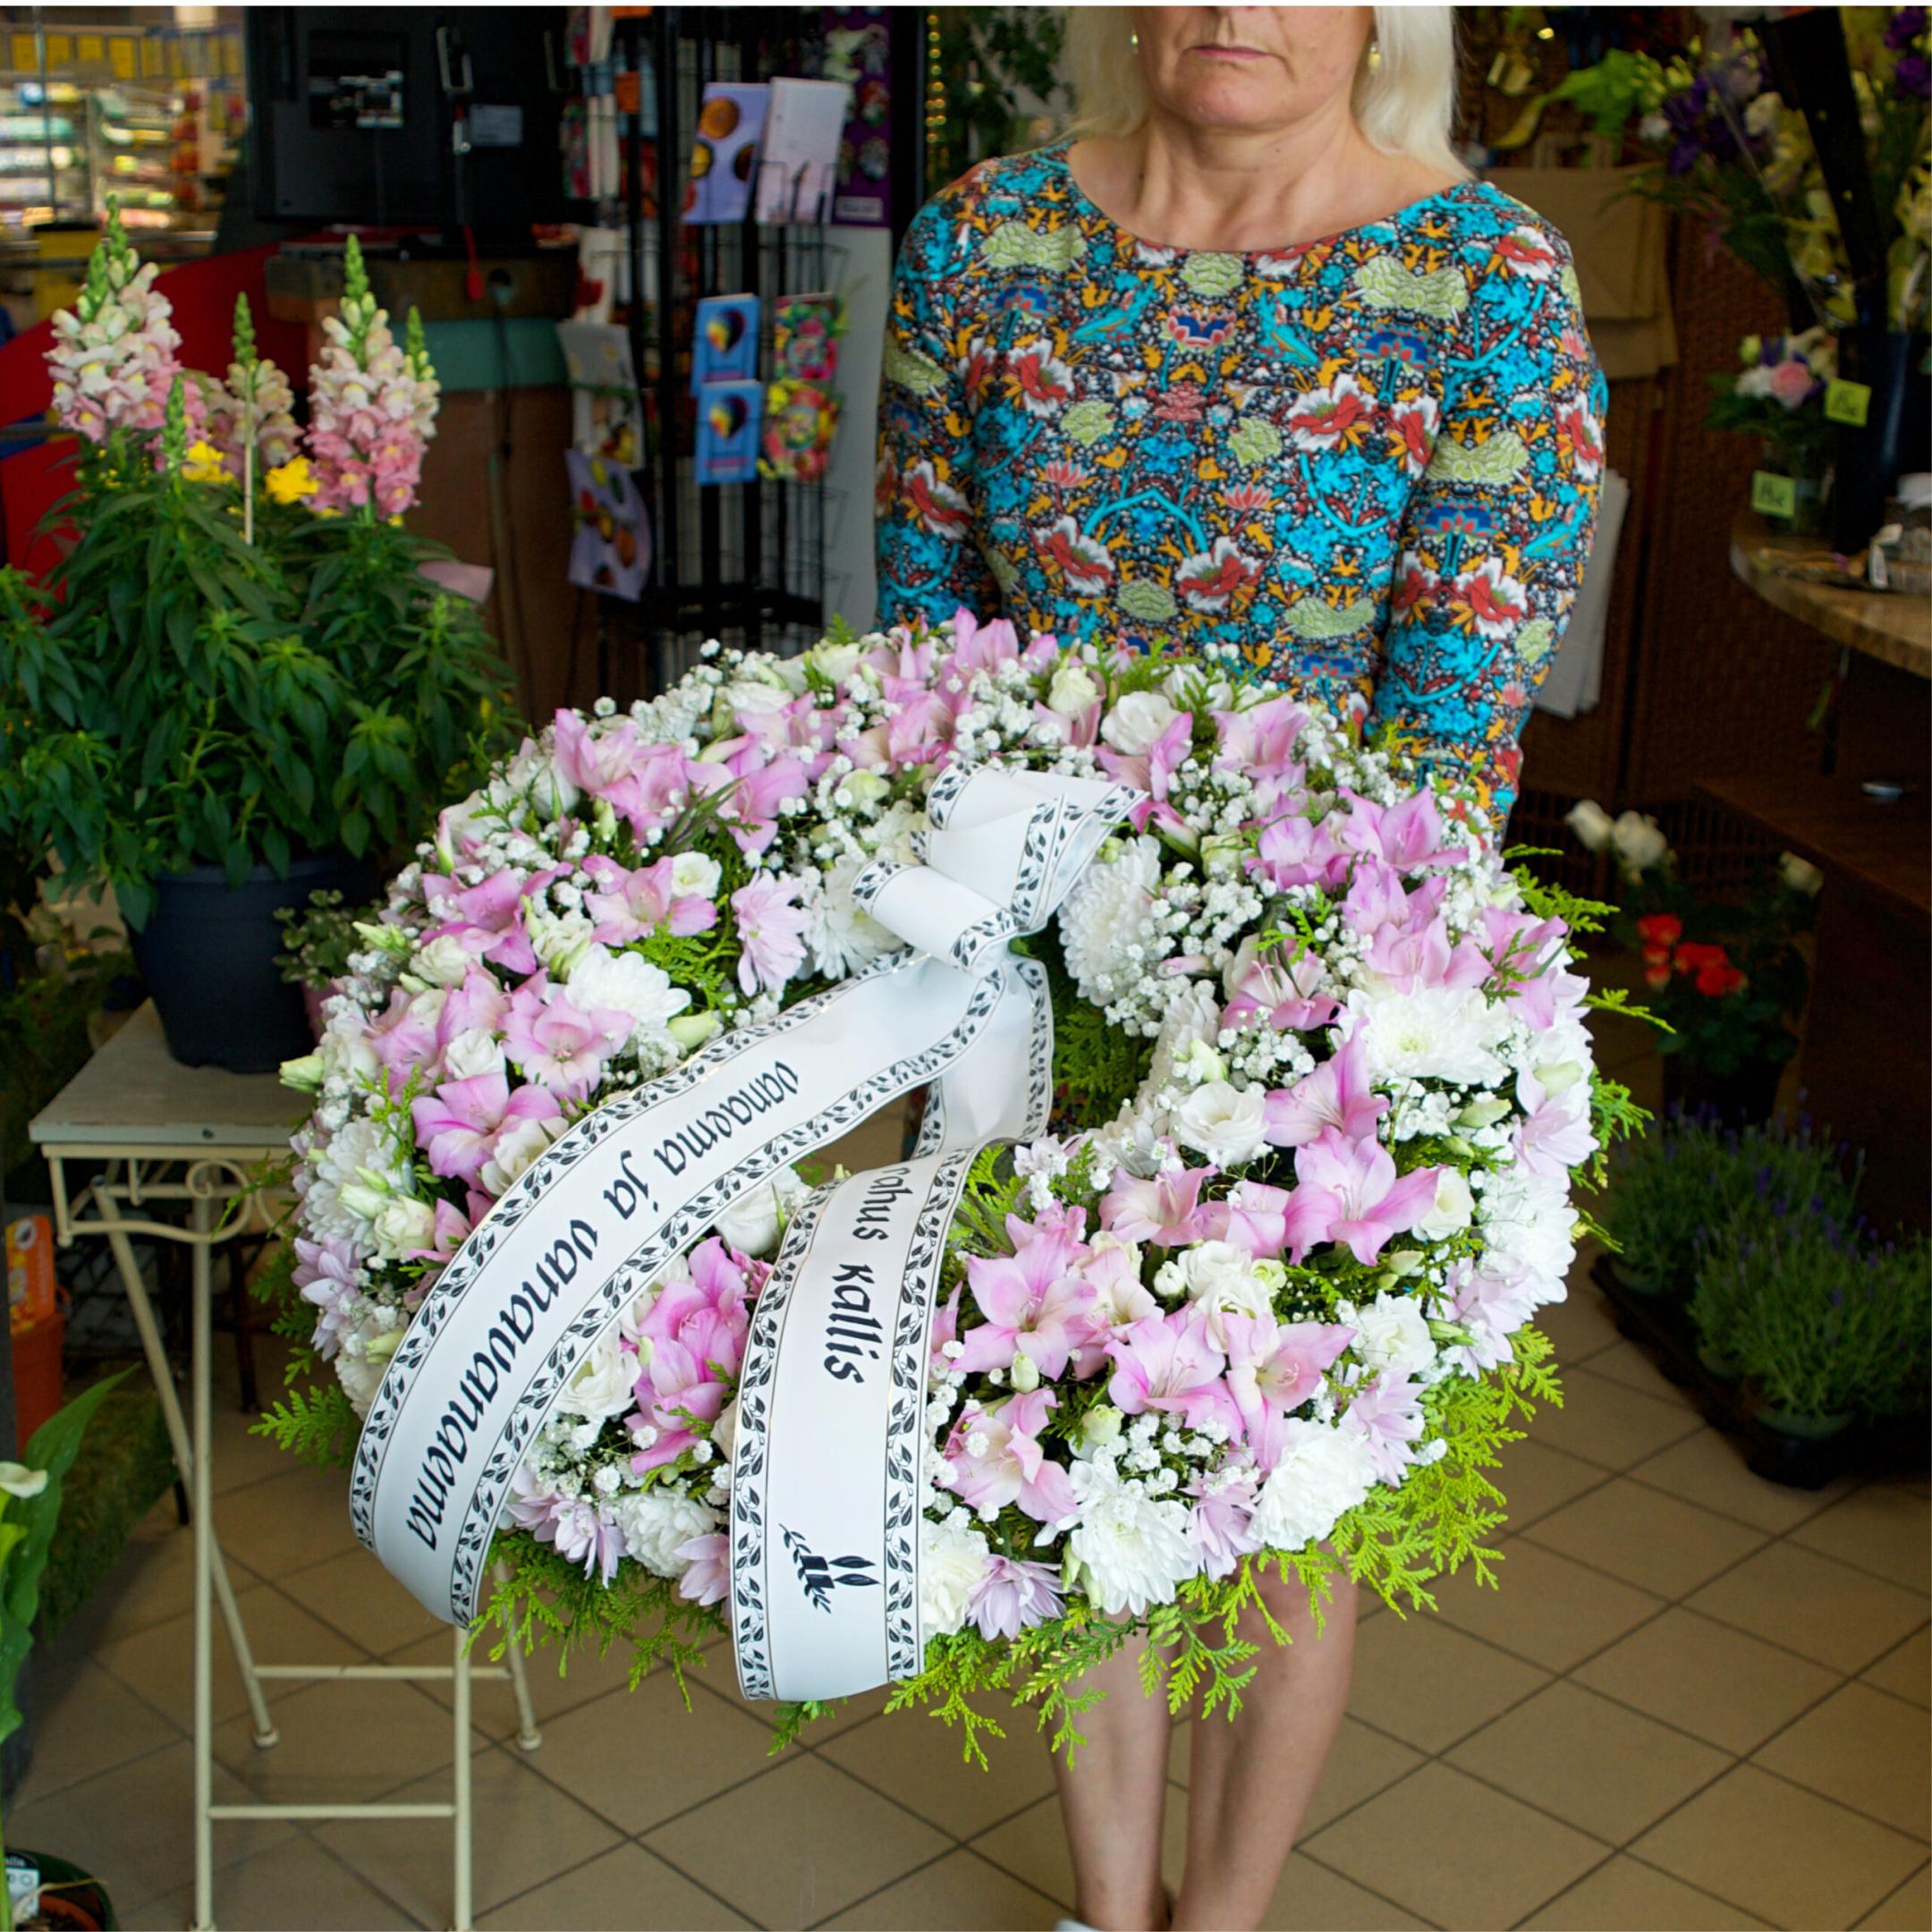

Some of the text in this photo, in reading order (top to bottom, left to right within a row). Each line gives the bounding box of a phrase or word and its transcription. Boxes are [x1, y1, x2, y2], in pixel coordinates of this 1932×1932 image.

[405, 1061, 799, 1551] vanaema ja vanavanaema
[824, 1264, 884, 1384] kallis
